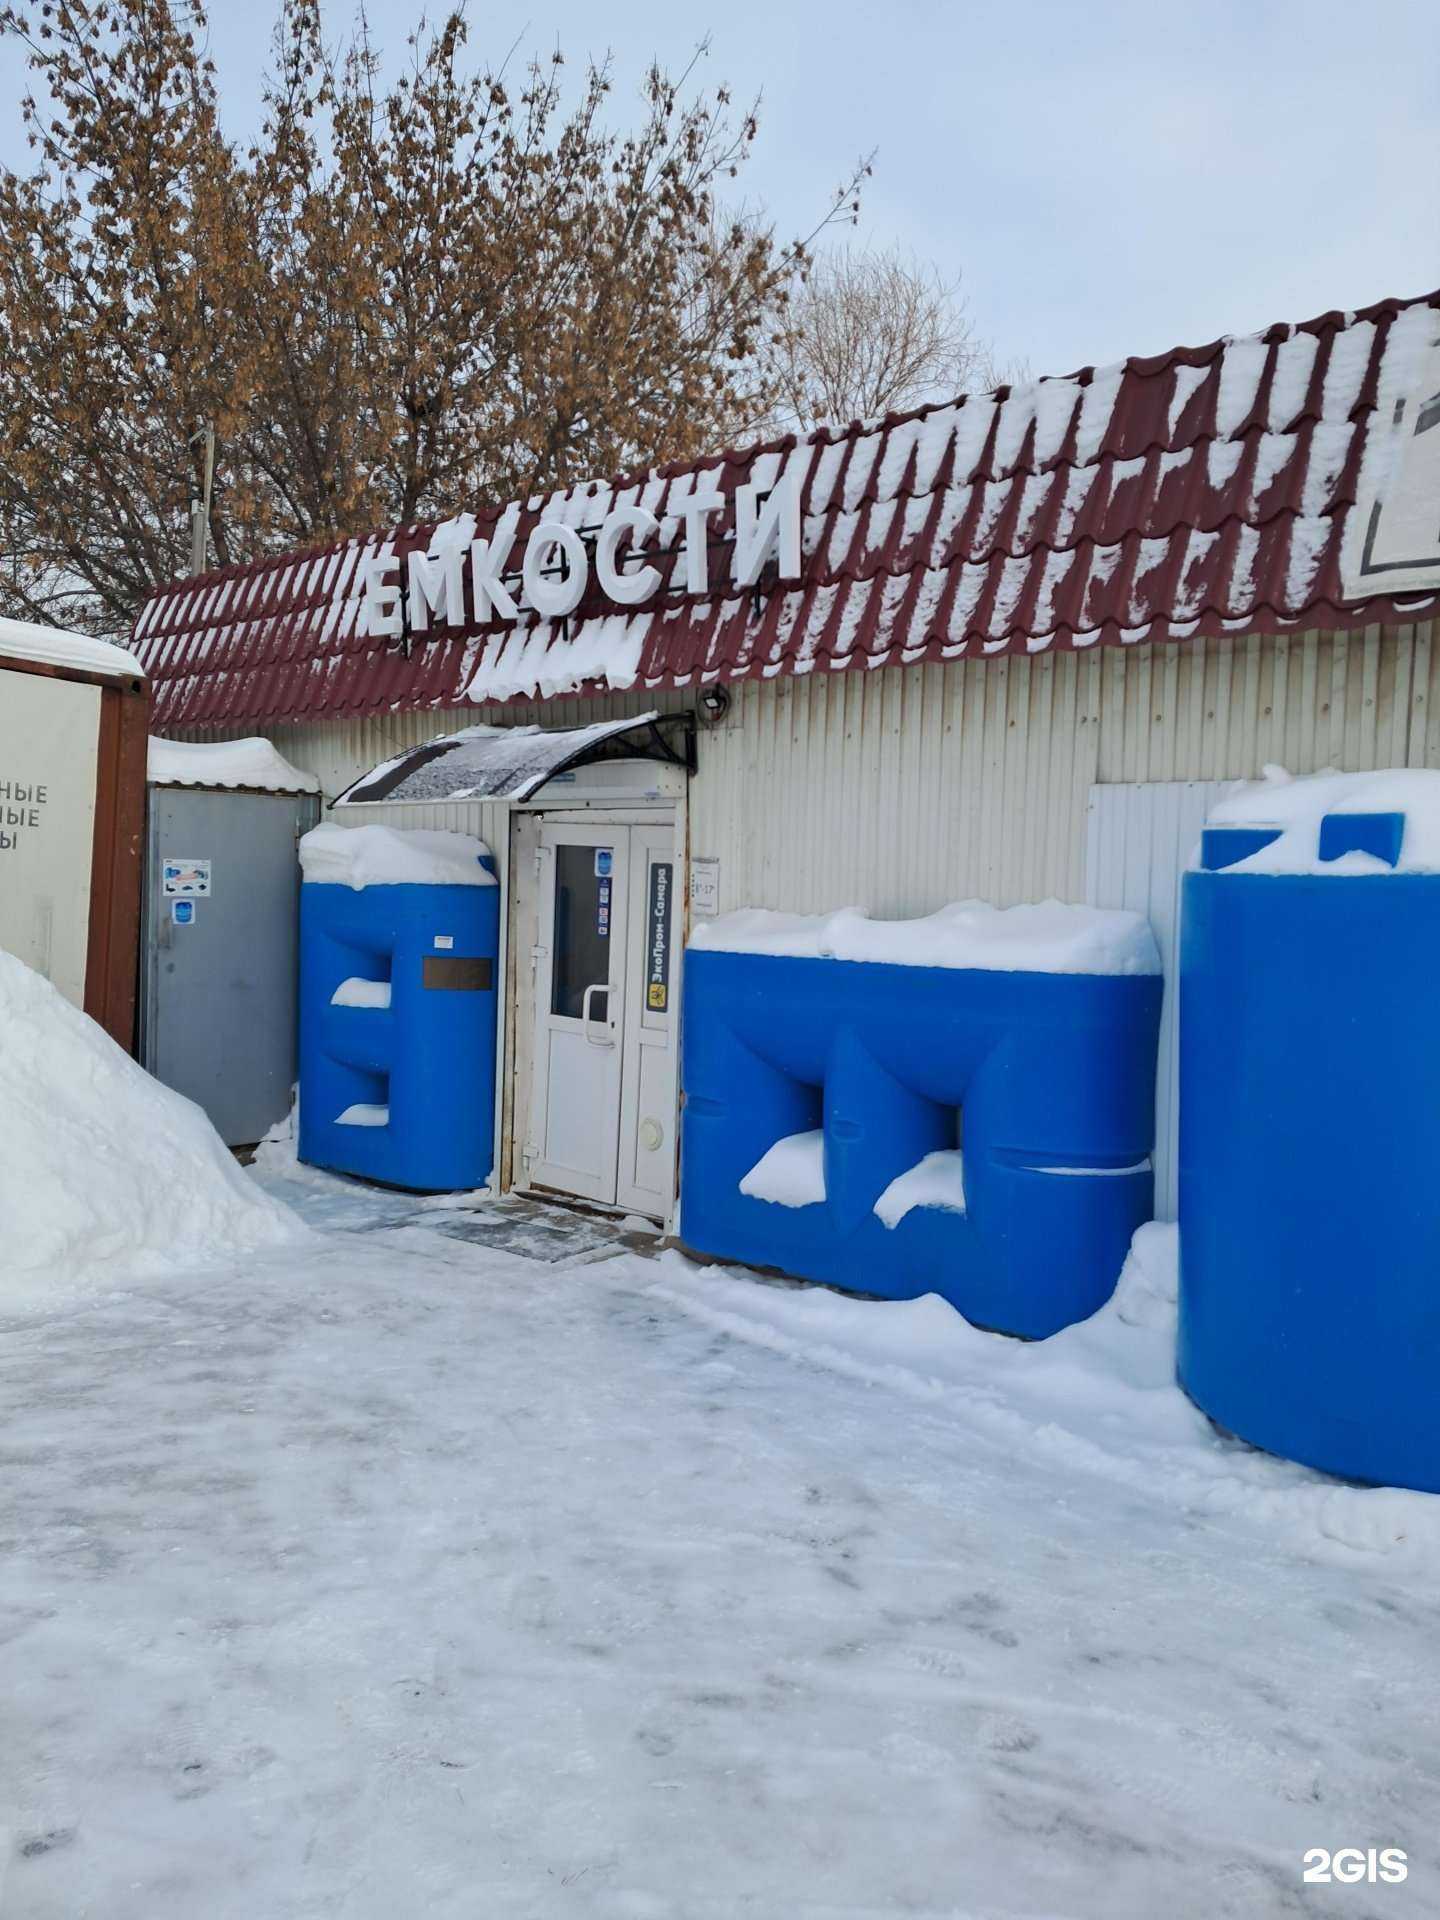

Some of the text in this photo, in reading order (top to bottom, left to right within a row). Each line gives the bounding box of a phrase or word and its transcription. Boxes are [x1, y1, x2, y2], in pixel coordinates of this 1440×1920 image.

[367, 475, 801, 636] ЕМКОСТИ
[0, 781, 47, 804] НЫЕ
[0, 806, 40, 827] ЫЕ
[652, 868, 668, 982] ЭкоПром-Самара
